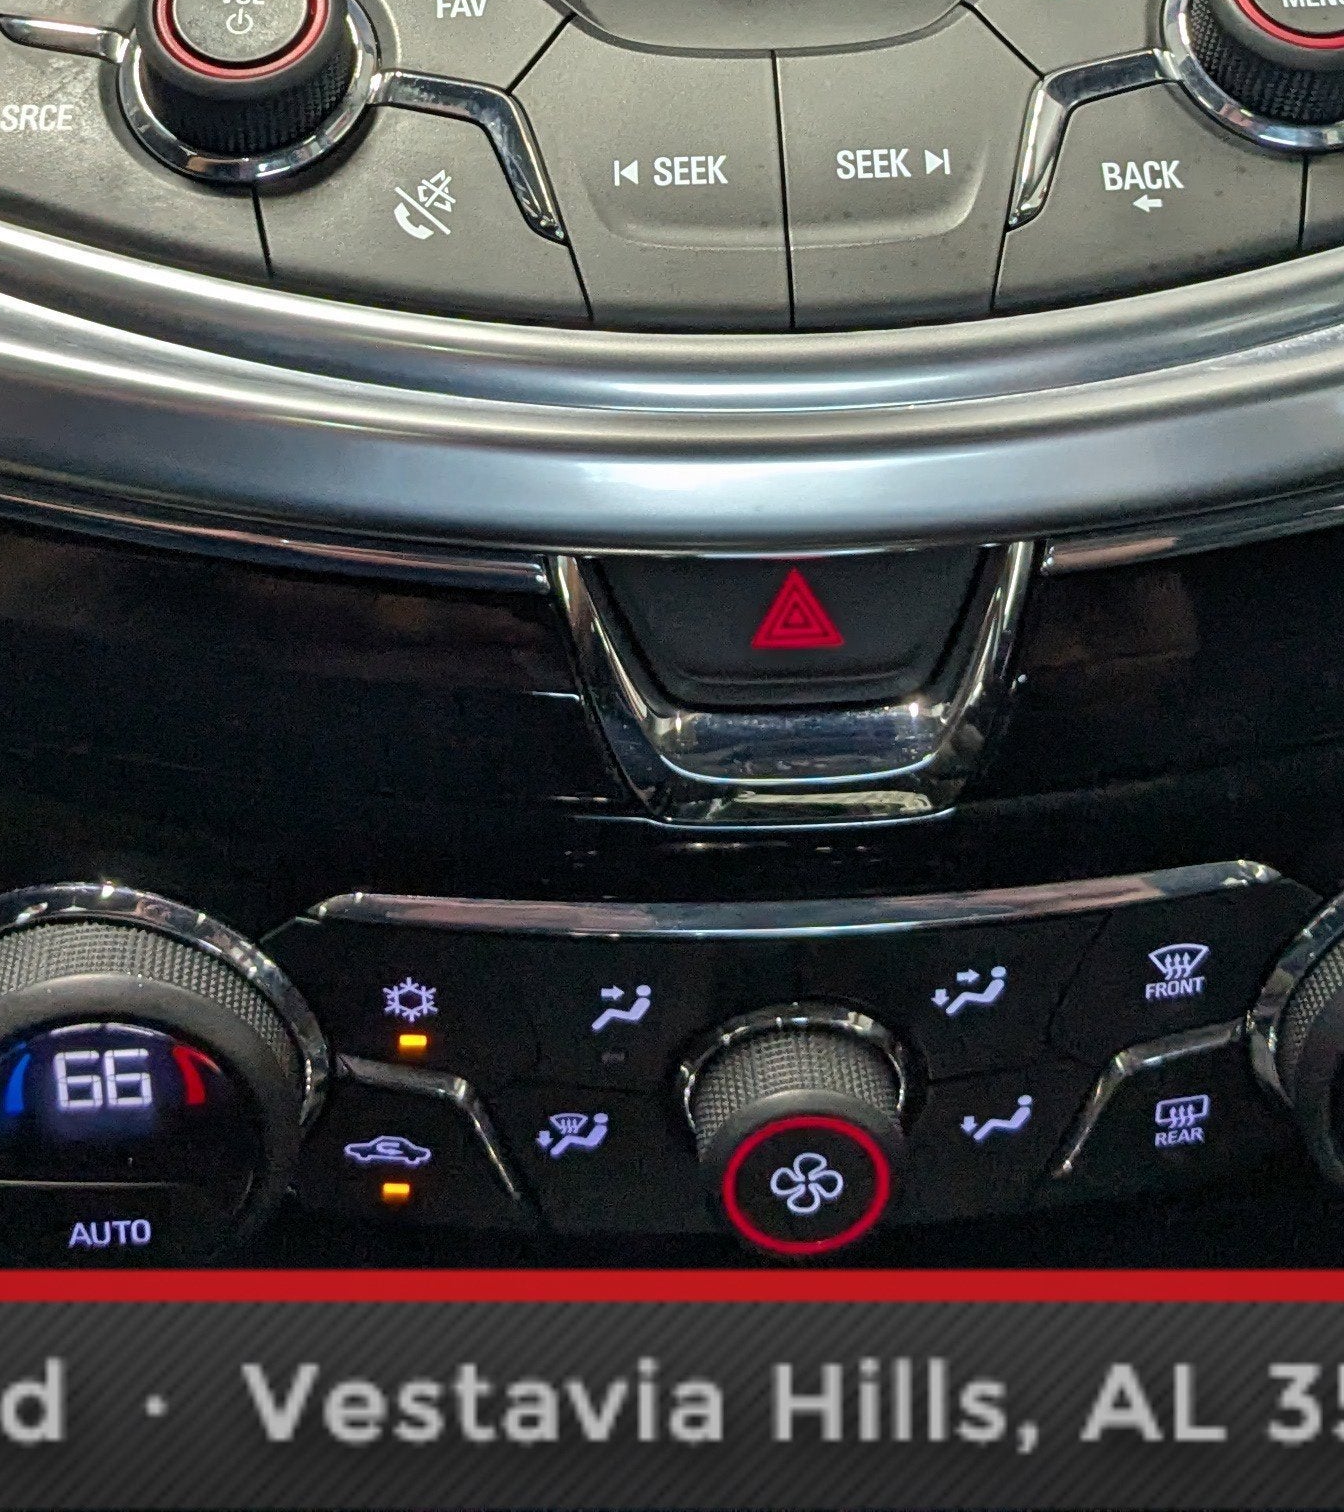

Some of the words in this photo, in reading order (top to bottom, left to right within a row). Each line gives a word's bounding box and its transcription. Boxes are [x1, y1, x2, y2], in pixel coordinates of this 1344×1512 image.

[0, 103, 75, 133] SRCE
[653, 154, 729, 187] SEEK
[836, 148, 912, 180] SEEK
[1101, 160, 1185, 191] BACK
[1145, 975, 1205, 1000] FRONT
[53, 1048, 153, 1110] 66
[1154, 1127, 1204, 1147] REAR
[68, 1218, 152, 1247] AUTO
